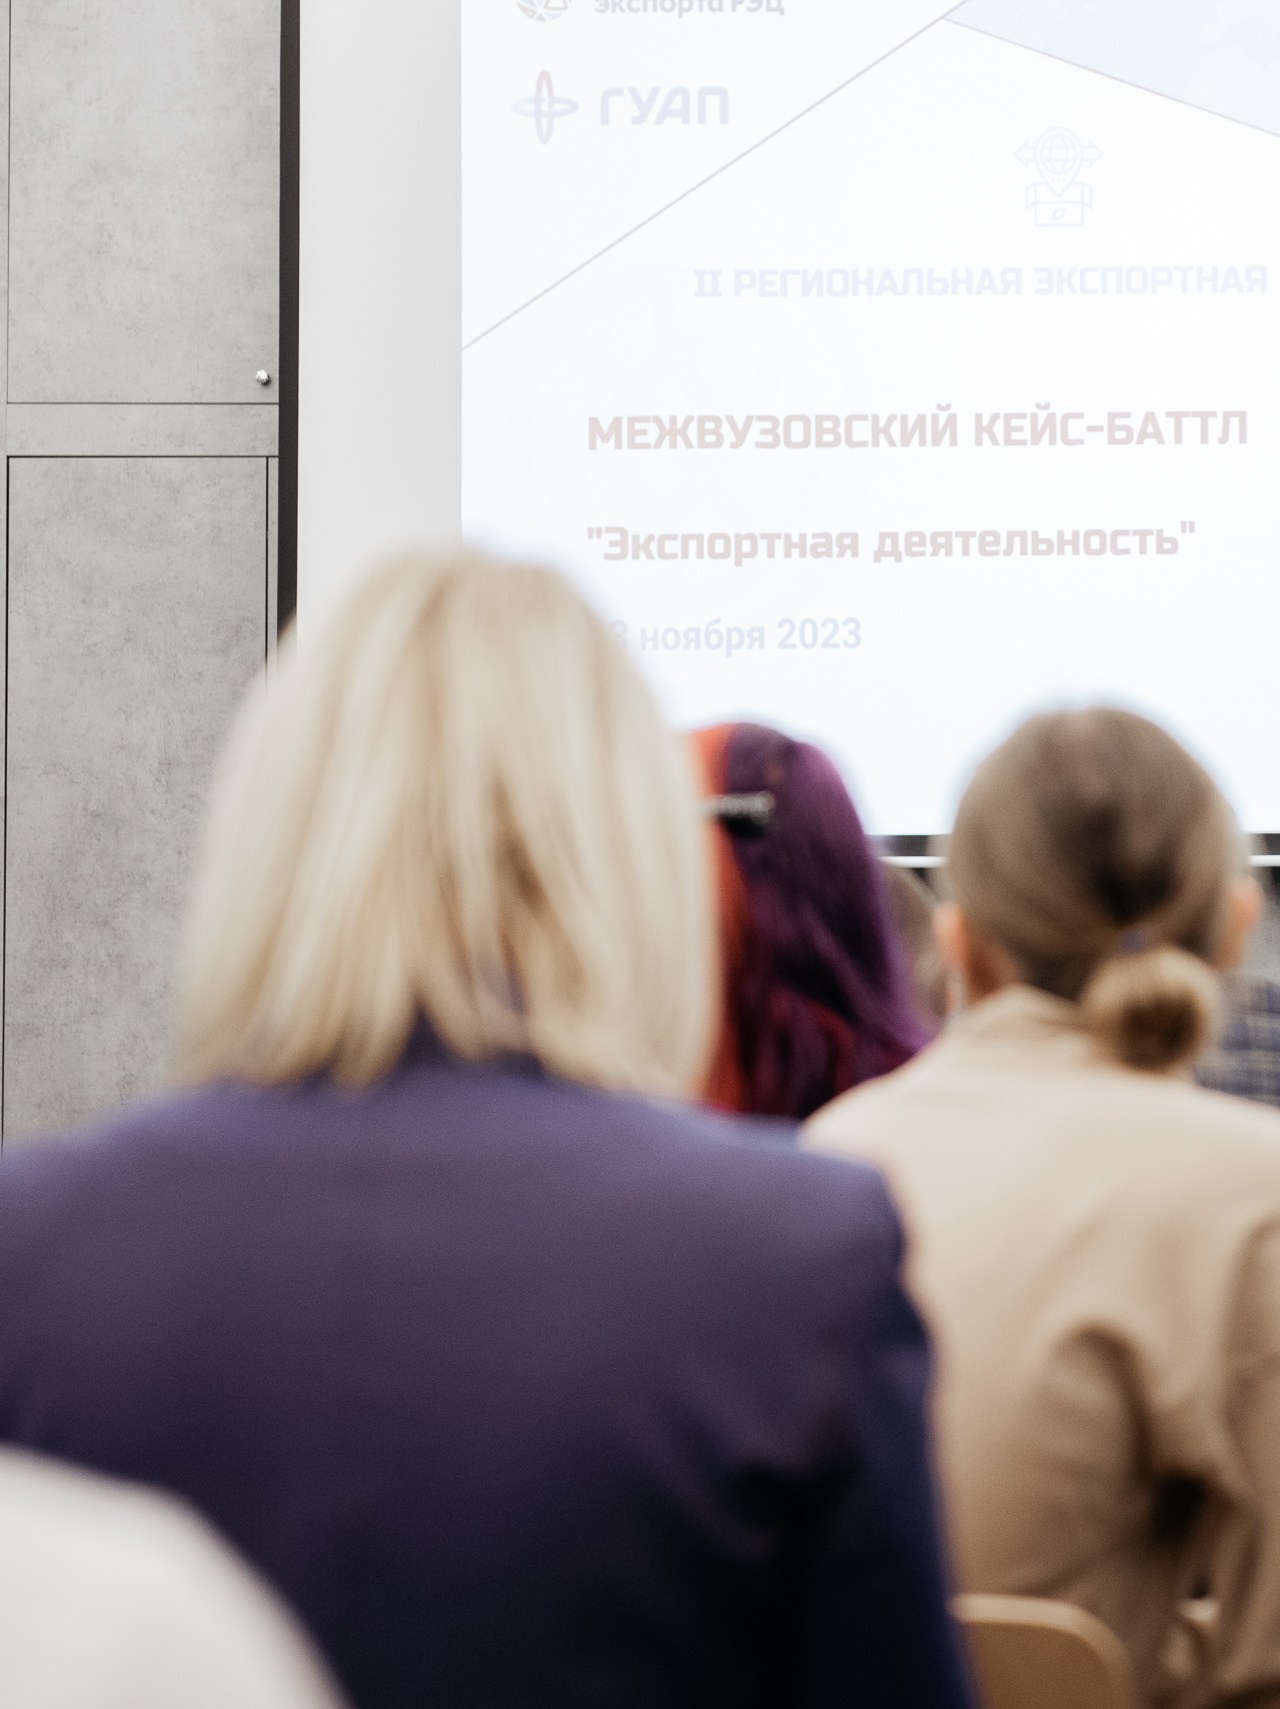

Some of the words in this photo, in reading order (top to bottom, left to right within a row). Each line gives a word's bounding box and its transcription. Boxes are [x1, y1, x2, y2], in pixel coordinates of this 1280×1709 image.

[600, 86, 729, 125] ГУАП
[733, 266, 1023, 298] РЕГИОНАЛЬНАЯ
[1033, 264, 1268, 295] ЭКСПОРТНАЯ
[587, 402, 958, 450] МЕЖВУЗОВСКИЙ
[973, 401, 1248, 447] КЕЙС-БАТТЛ
[587, 525, 860, 568] "Экспортная
[873, 520, 1196, 564] деятельность"
[639, 616, 767, 659] ноября
[776, 617, 862, 650] 2023
